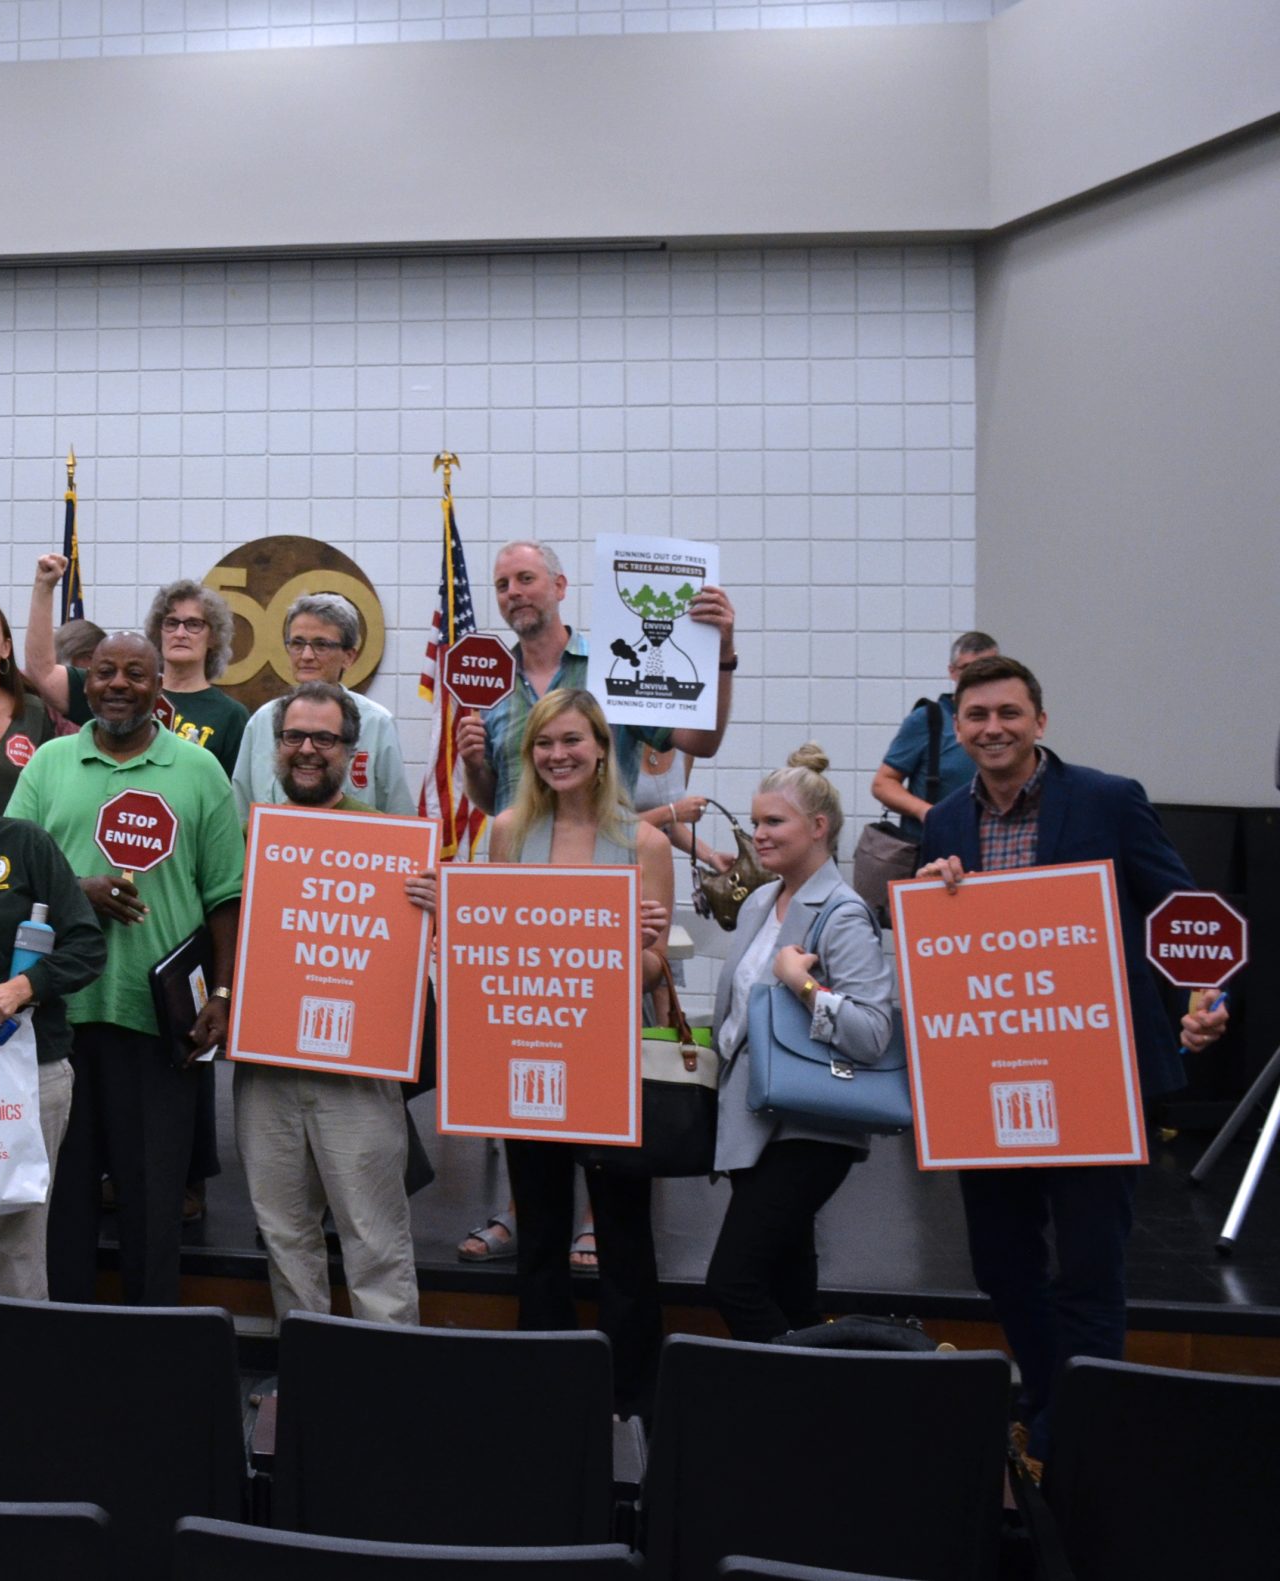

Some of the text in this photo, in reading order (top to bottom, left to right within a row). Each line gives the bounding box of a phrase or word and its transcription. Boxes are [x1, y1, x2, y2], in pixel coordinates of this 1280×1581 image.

[614, 550, 706, 565] RUNNING OUT OF TREES
[617, 562, 628, 570] NC
[630, 563, 652, 572] TREES
[672, 567, 703, 576] FORESTS
[201, 566, 384, 690] 50
[643, 622, 672, 630] ENVIVA
[461, 655, 498, 669] STOP
[452, 672, 505, 689] ENVIVA
[639, 682, 669, 691] ENVIVA
[606, 699, 697, 711] RUNNING OUT OF TIME
[117, 812, 158, 828] STOP
[105, 830, 162, 851] ENVIVA
[265, 844, 419, 874] GOV COOPER:
[301, 877, 375, 904] STOP
[281, 908, 389, 940] ENVIVA
[456, 906, 620, 927] GOV COOPER:
[1170, 920, 1221, 935] STOP
[916, 925, 1098, 957] GOV COOPER:
[294, 942, 370, 971] NOW
[452, 945, 624, 970] THIS IS YOUR
[1159, 943, 1234, 961] ENVIVA
[305, 973, 354, 986] #StopEnviva
[481, 975, 594, 999] CLIMATE
[967, 970, 1055, 1000] NC IS
[487, 1004, 587, 1028] LEGACY
[922, 1004, 1110, 1039] WATCHING
[511, 1039, 563, 1049] #StopEnviva
[991, 1058, 1048, 1069] #StopEnviva
